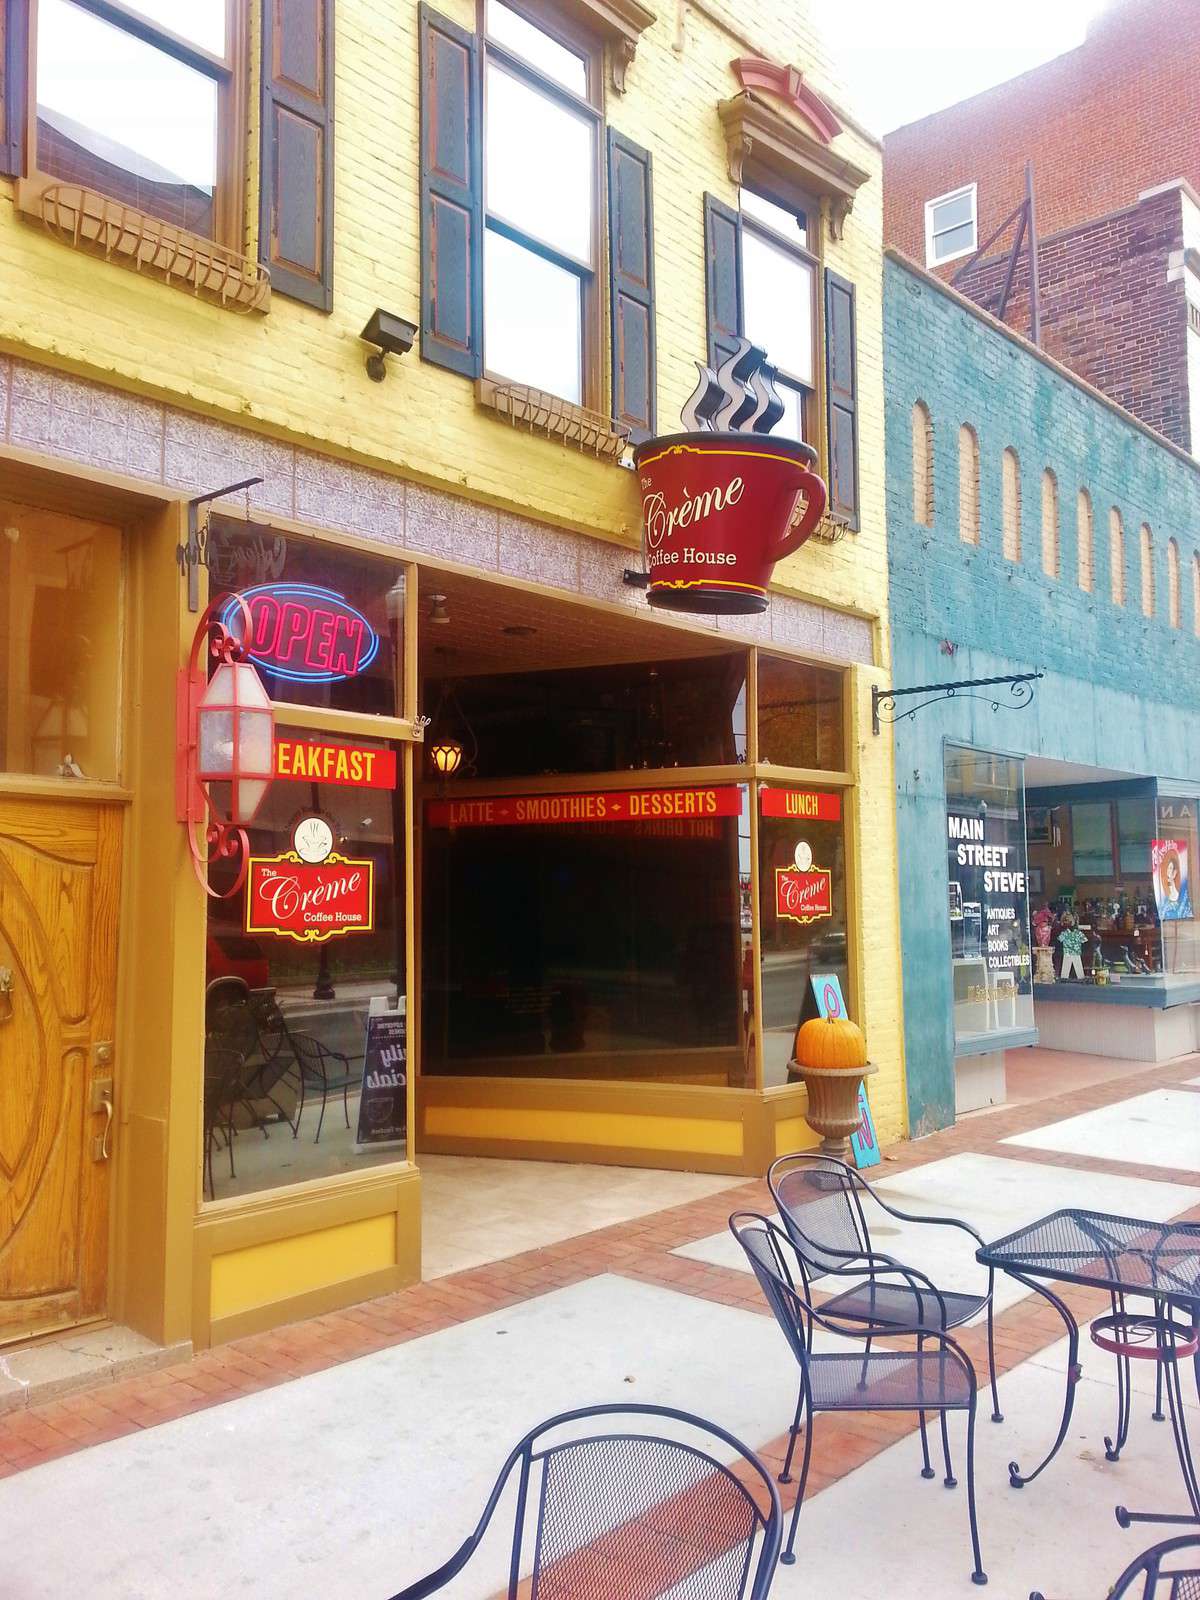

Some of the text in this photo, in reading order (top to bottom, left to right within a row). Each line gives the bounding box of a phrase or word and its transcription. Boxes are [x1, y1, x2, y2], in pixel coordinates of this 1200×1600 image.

[642, 475, 745, 549] Crème
[682, 547, 737, 566] House
[248, 594, 364, 677] OPEN
[277, 742, 376, 782] EAKFAST
[449, 790, 717, 824] LATTE SMOOTHIES DESSERTS
[785, 793, 819, 816] LUNCH
[948, 816, 984, 841] MAIN
[957, 844, 1009, 867] STREET
[261, 868, 277, 877] The
[983, 871, 1025, 894] STEVE
[259, 871, 362, 920] Crème
[780, 877, 827, 910] Crème
[303, 911, 362, 923] Coffee House
[986, 908, 1015, 920] ANTIQUES
[987, 924, 1000, 936] ART
[987, 940, 1009, 953] BOOKS
[988, 955, 1030, 969] COLLECTIBLES
